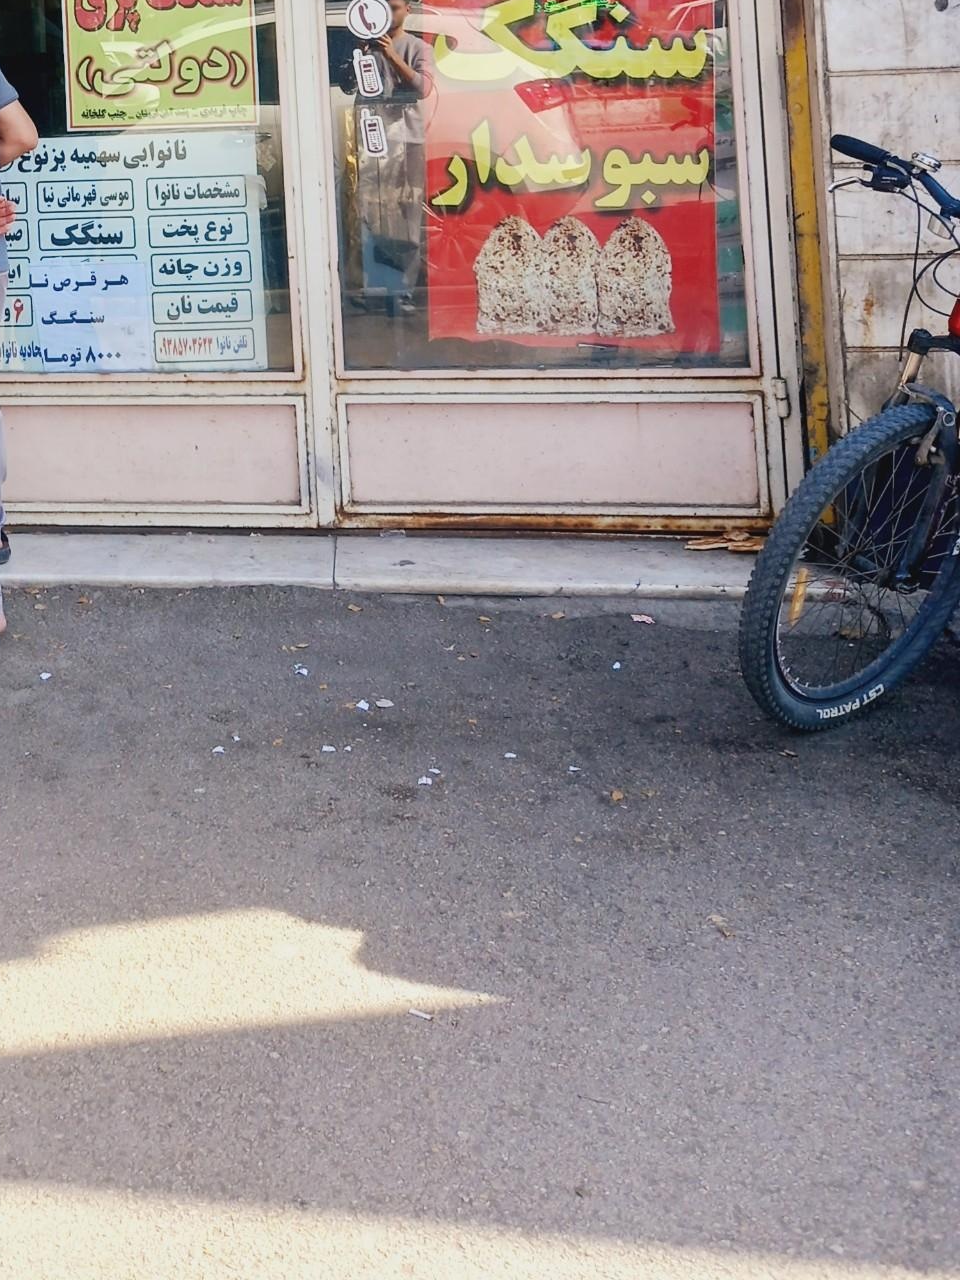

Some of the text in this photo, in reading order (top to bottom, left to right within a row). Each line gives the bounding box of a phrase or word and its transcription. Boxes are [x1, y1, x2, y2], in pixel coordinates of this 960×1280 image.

[70, 145, 121, 170] سهمیه
[123, 138, 187, 170] نانوایی
[57, 184, 97, 208] قهرمانی
[99, 191, 129, 207] موسی
[154, 181, 240, 207] مشخصات نانوا
[50, 220, 123, 247] سنگک
[162, 217, 234, 243] نوع پخت
[52, 271, 97, 291] قرص
[158, 257, 243, 280] وزن چانه
[101, 274, 129, 290] هر
[166, 292, 239, 321] قیمت نان
[43, 345, 122, 367] ۸۰۰۰ توما
[816, 683, 885, 719] CST PATROL
